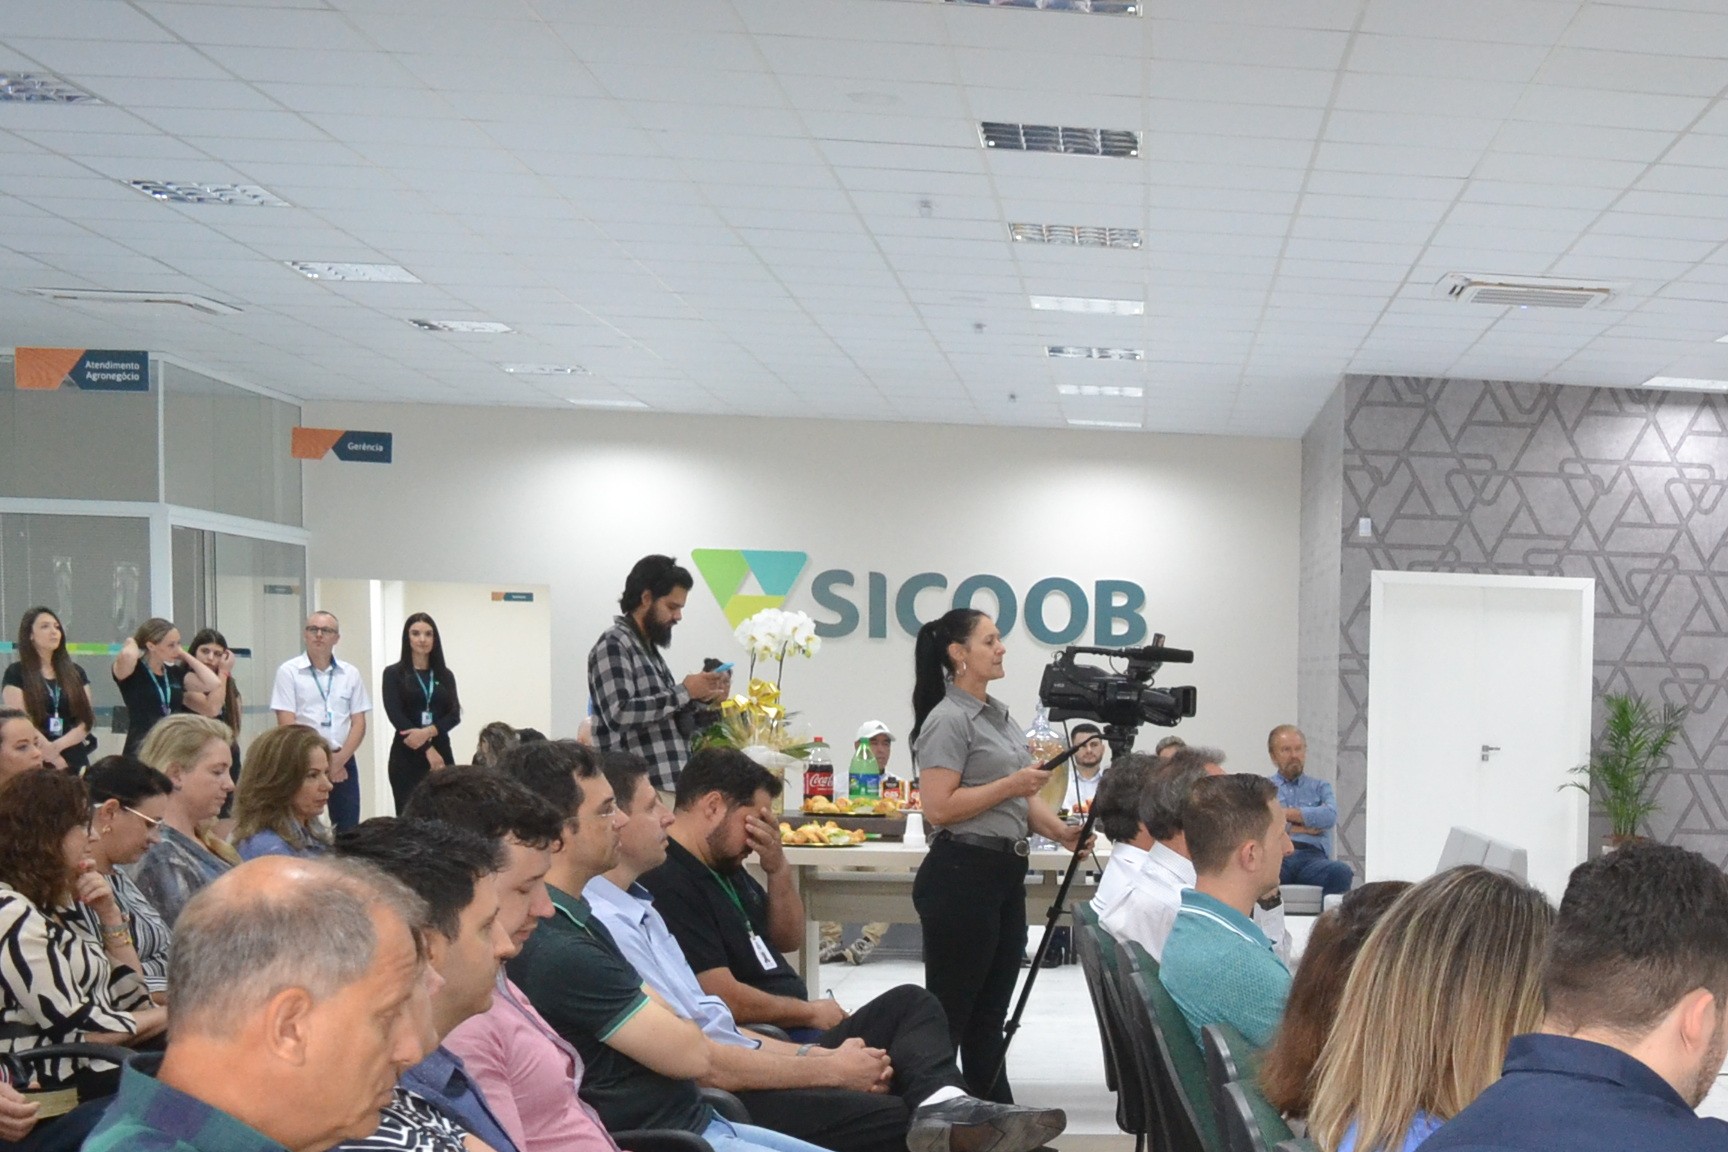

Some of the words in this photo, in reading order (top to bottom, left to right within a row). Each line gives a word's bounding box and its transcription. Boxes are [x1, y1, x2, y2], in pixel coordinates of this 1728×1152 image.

[85, 360, 140, 370] Atendimento
[85, 371, 140, 382] Agronegócio
[347, 442, 384, 452] Gerência
[811, 569, 1148, 647] SICOOB
